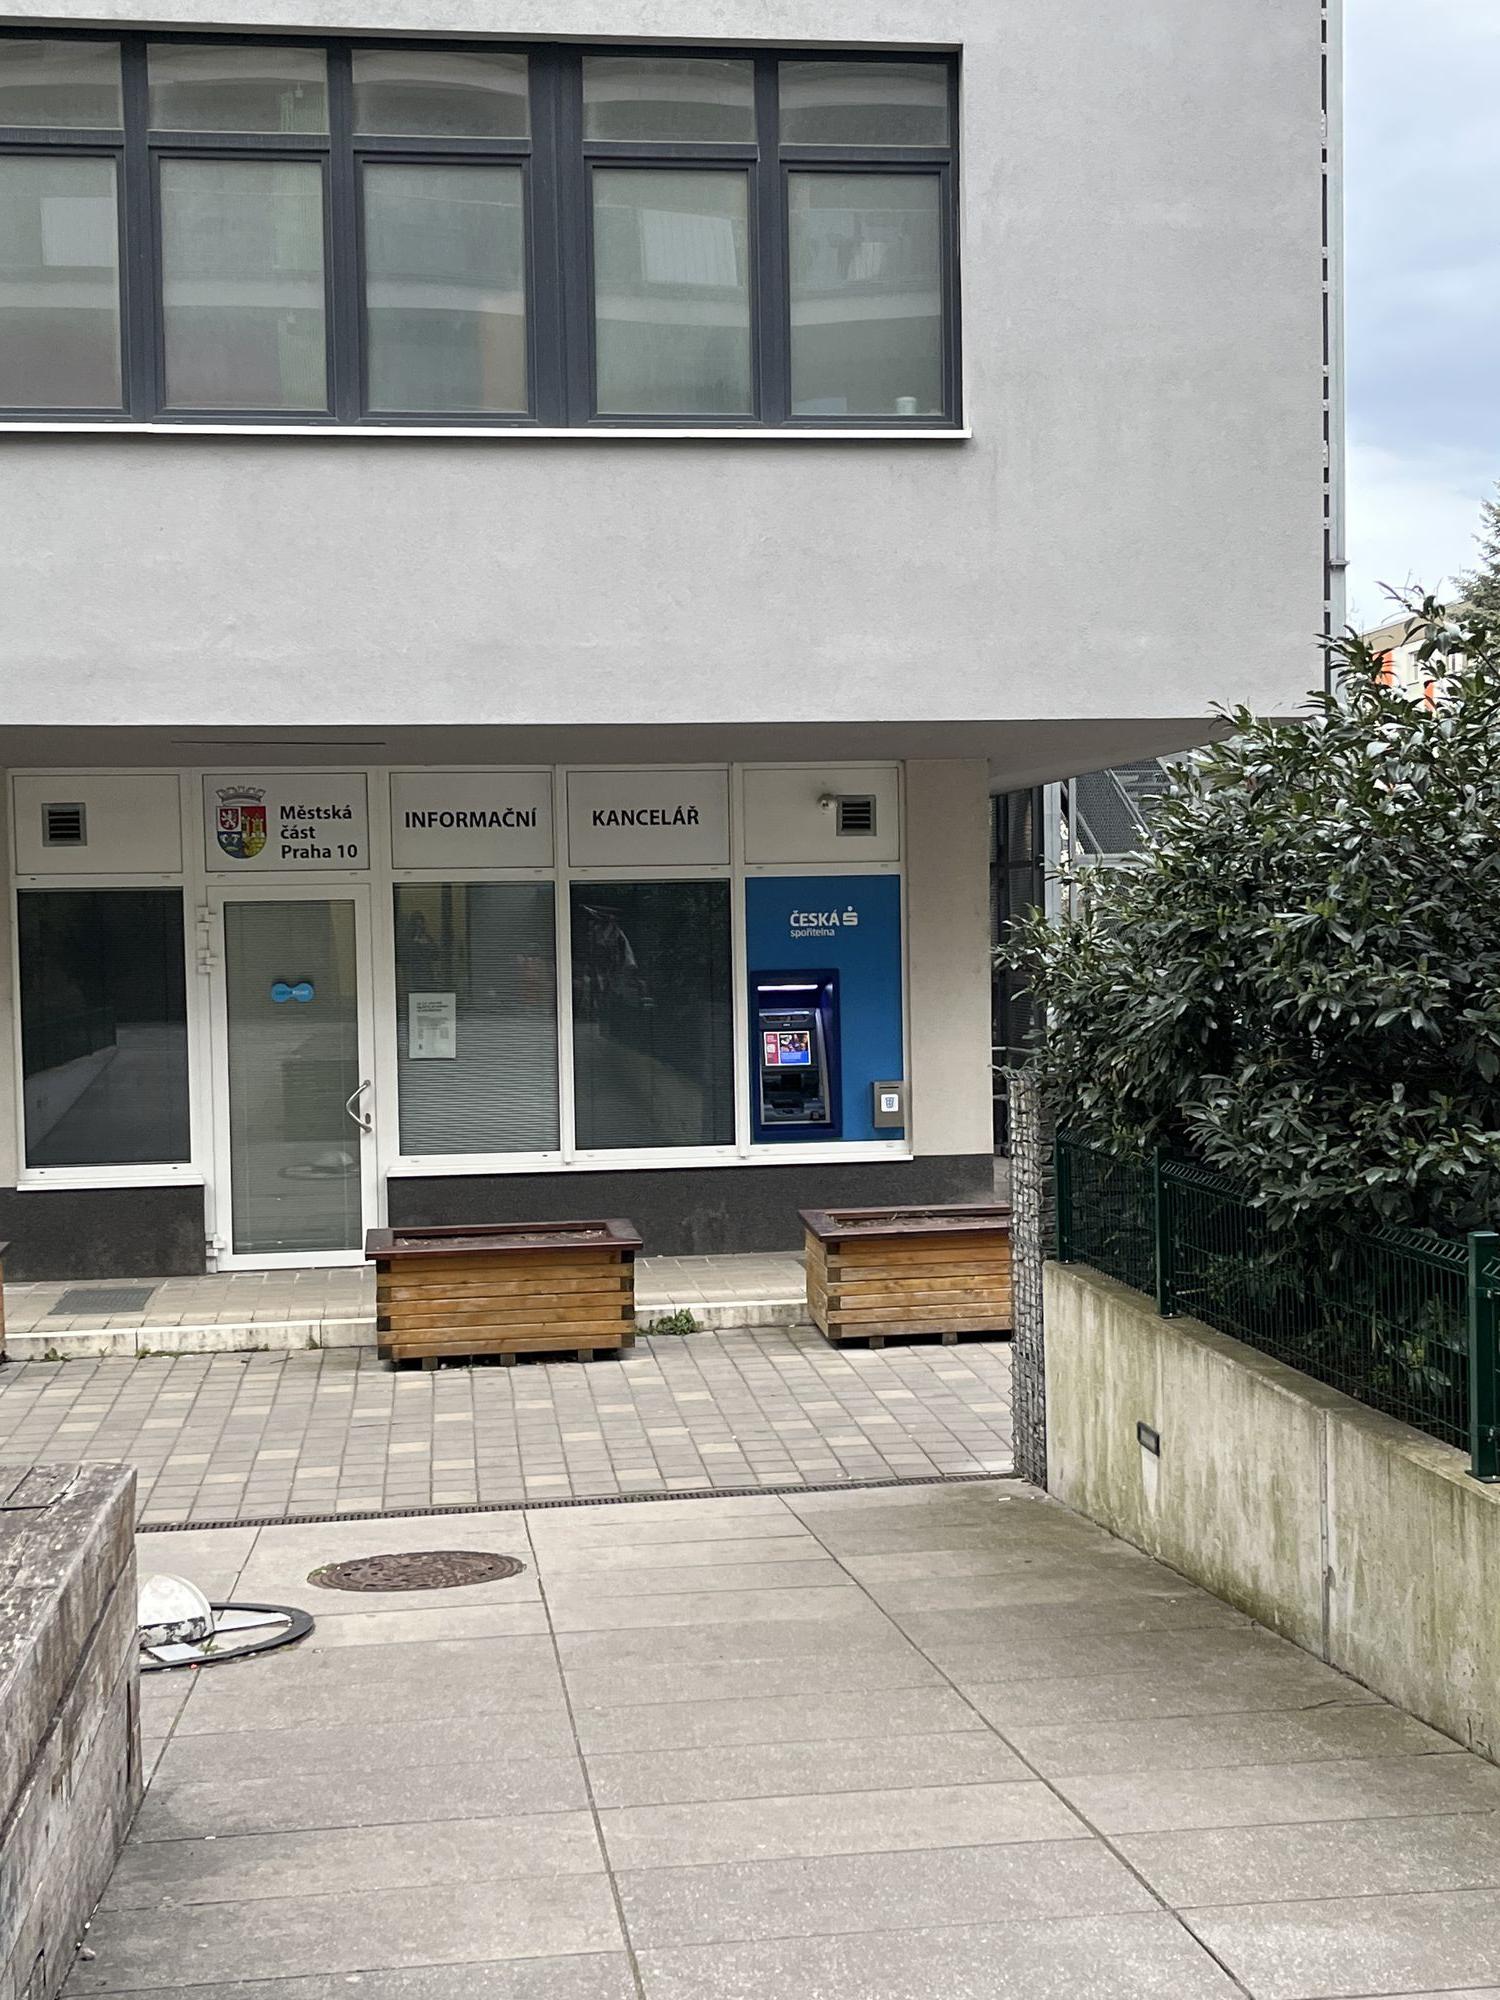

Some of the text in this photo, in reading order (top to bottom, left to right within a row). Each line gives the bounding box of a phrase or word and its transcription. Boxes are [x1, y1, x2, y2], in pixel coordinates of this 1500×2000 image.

[280, 805, 352, 819] Městská
[405, 807, 537, 828] INFORMAČNÍ
[592, 805, 699, 826] KANCELÁŘ
[280, 824, 316, 839] část
[281, 844, 358, 859] Praha 10
[790, 909, 840, 927] ČESKÁ
